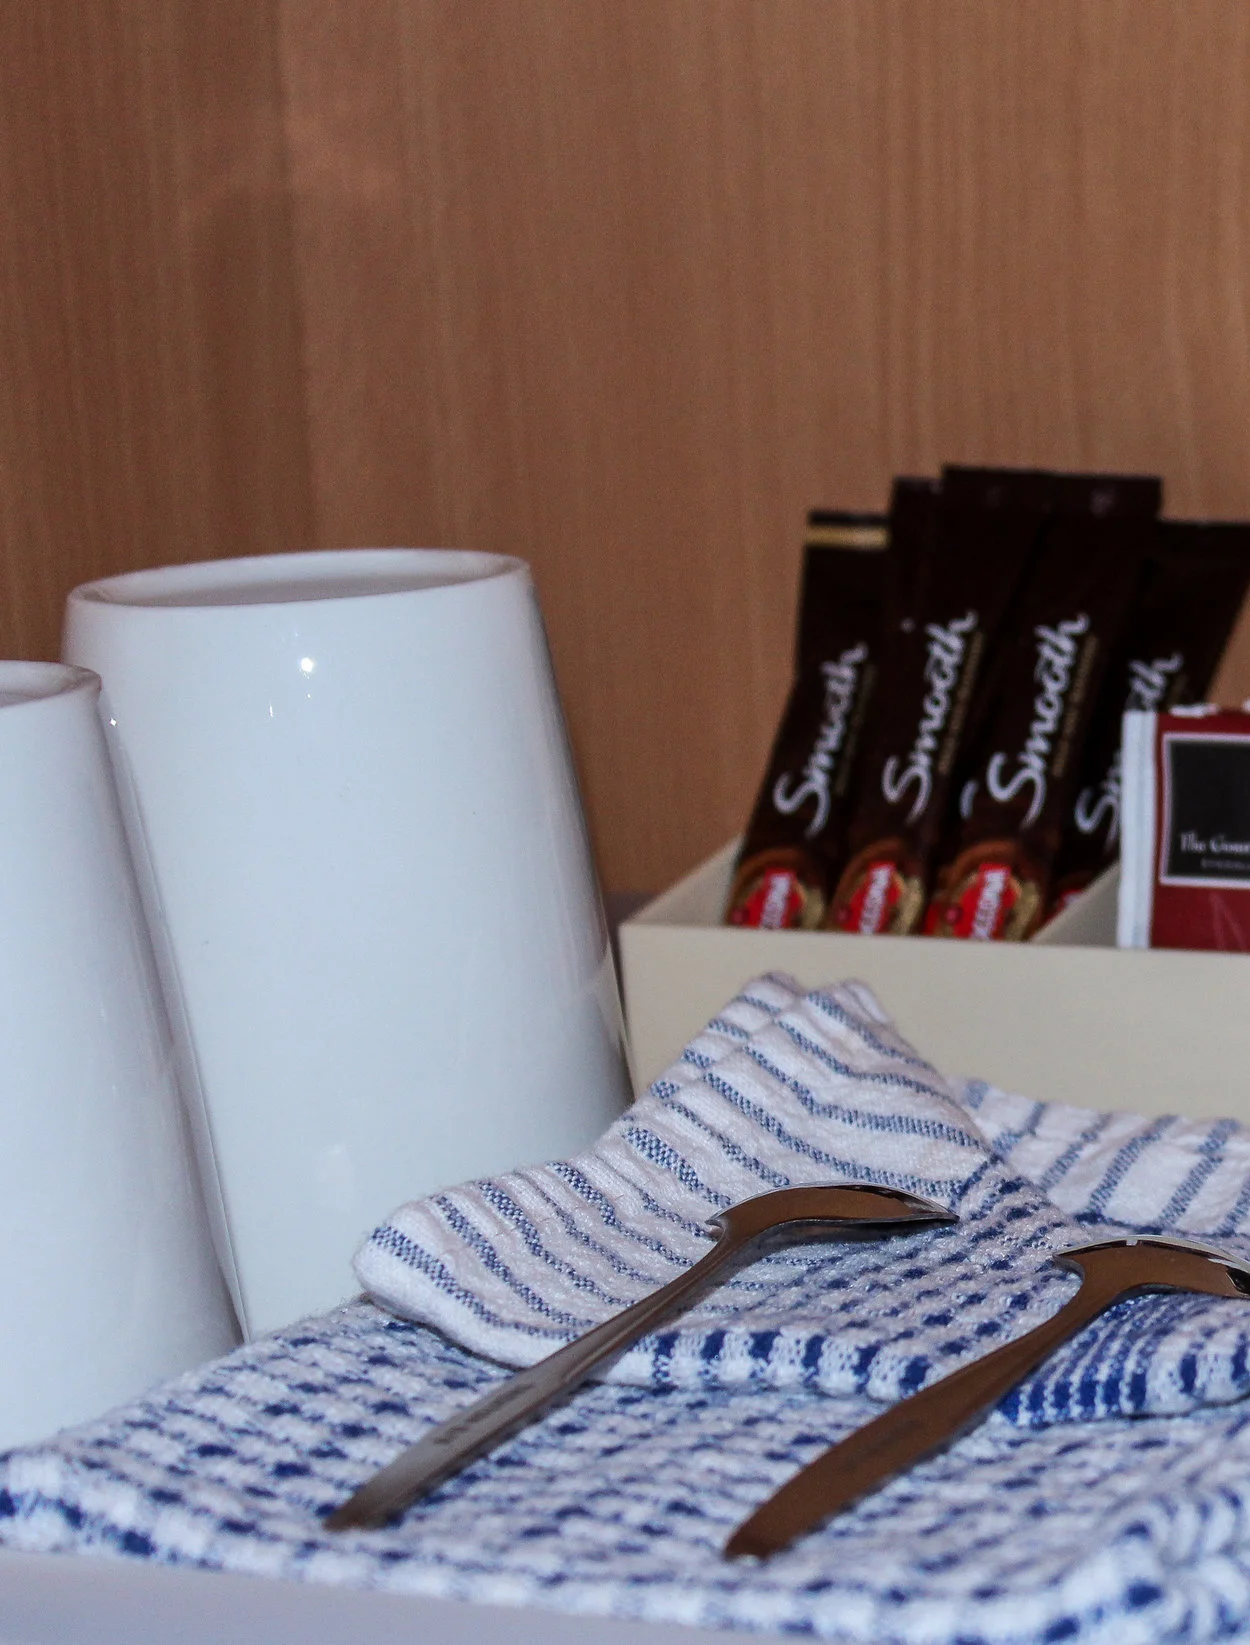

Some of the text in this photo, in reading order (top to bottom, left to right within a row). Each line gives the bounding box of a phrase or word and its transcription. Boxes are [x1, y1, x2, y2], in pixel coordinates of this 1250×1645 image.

[773, 642, 869, 839] Smooth
[883, 610, 979, 825] Smooth
[986, 612, 1090, 829] Smooth
